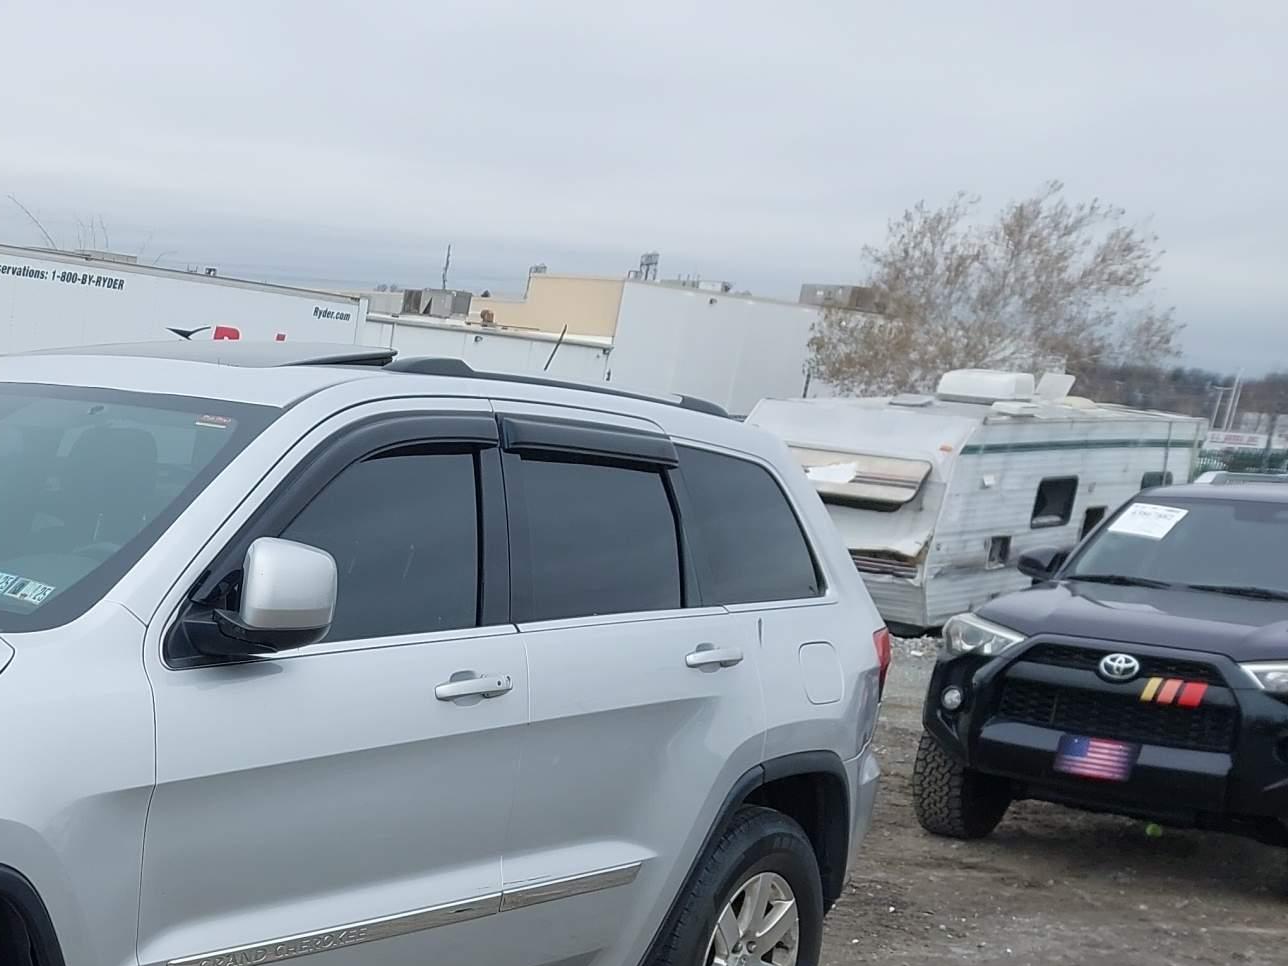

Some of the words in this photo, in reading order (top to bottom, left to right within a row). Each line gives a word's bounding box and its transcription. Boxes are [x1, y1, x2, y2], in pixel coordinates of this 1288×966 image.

[52, 270, 125, 290] 1-800-BY-RYDER
[313, 306, 351, 321] Ryder.com
[275, 927, 368, 959] CHEROKEE
